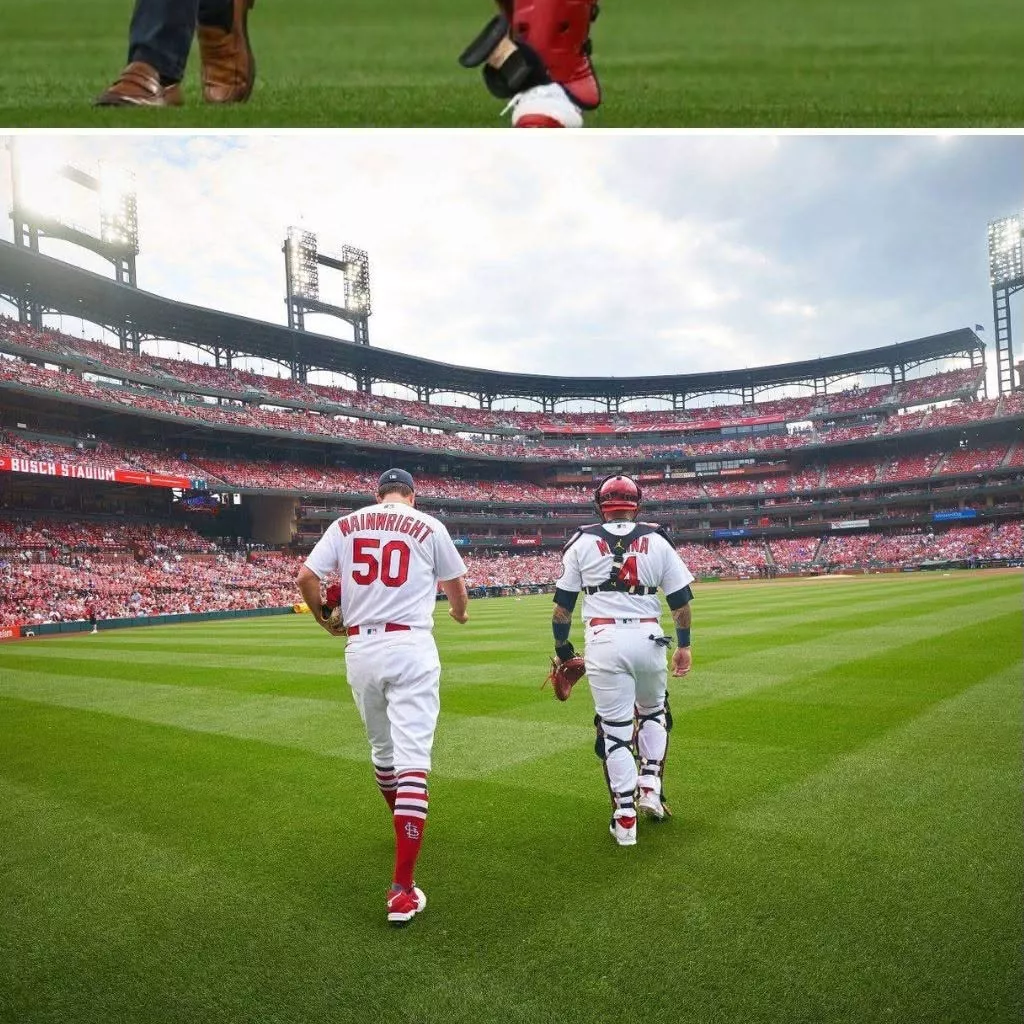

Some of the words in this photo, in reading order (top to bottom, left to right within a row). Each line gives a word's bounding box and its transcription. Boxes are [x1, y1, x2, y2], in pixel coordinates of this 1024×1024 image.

[11, 458, 56, 476] BUSCH
[61, 462, 116, 482] STADIUM
[337, 512, 434, 544] WAINWRIGHT
[352, 537, 411, 588] 50
